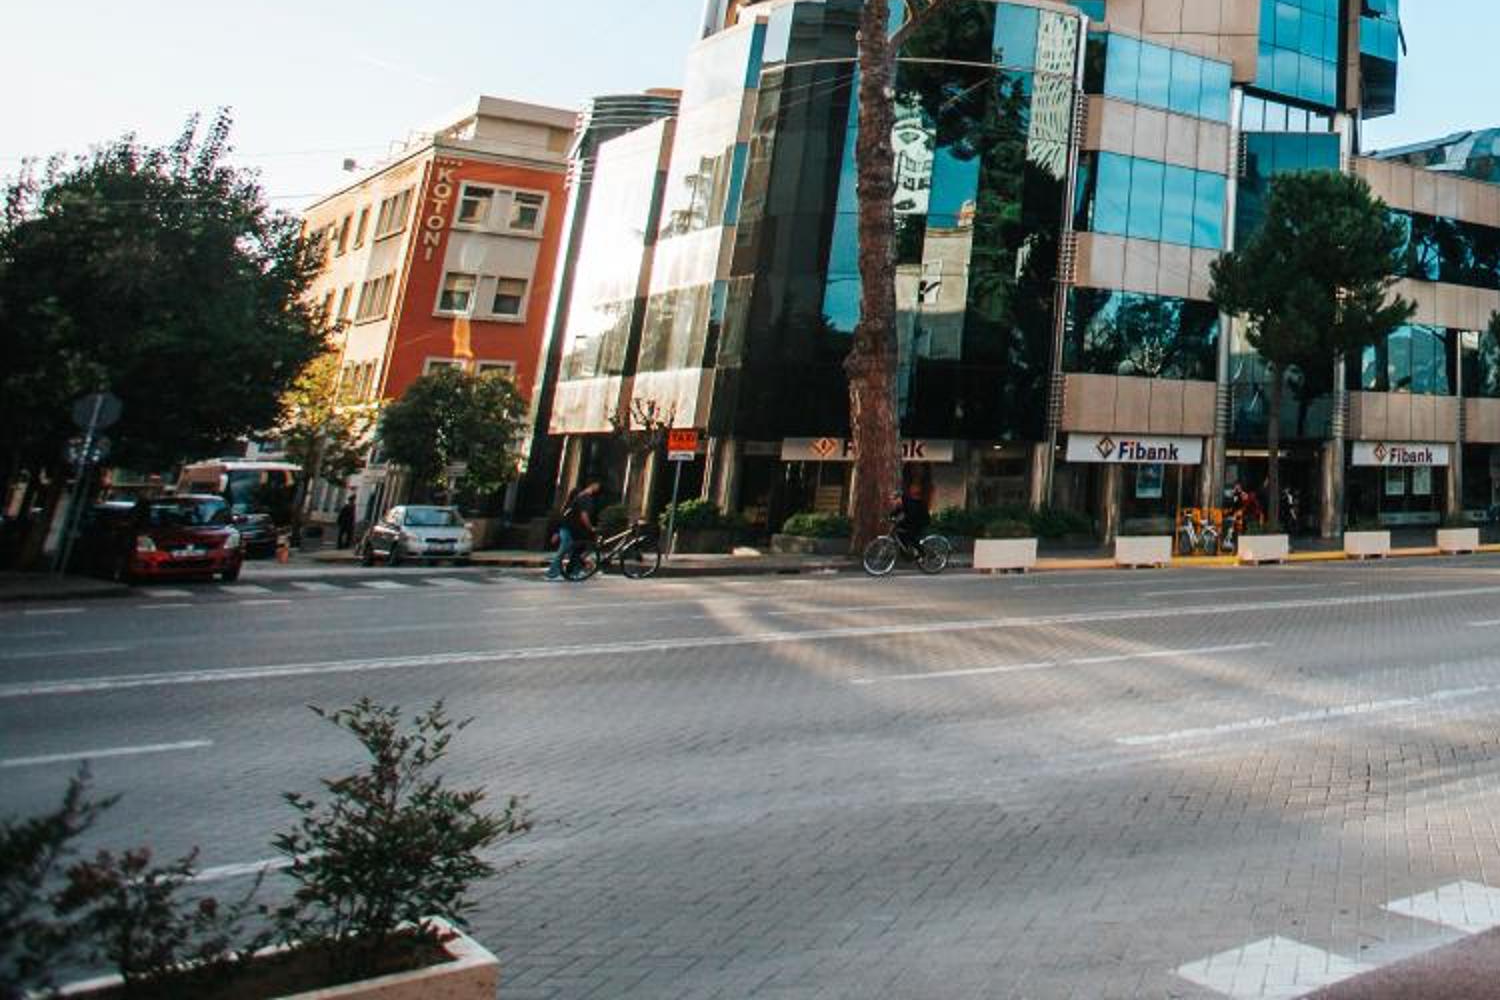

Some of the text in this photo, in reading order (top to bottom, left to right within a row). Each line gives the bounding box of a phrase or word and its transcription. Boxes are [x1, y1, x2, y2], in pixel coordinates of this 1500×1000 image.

[424, 167, 456, 261] KOTONI
[1118, 440, 1179, 461] Fibank
[1389, 446, 1433, 463] Fibank
